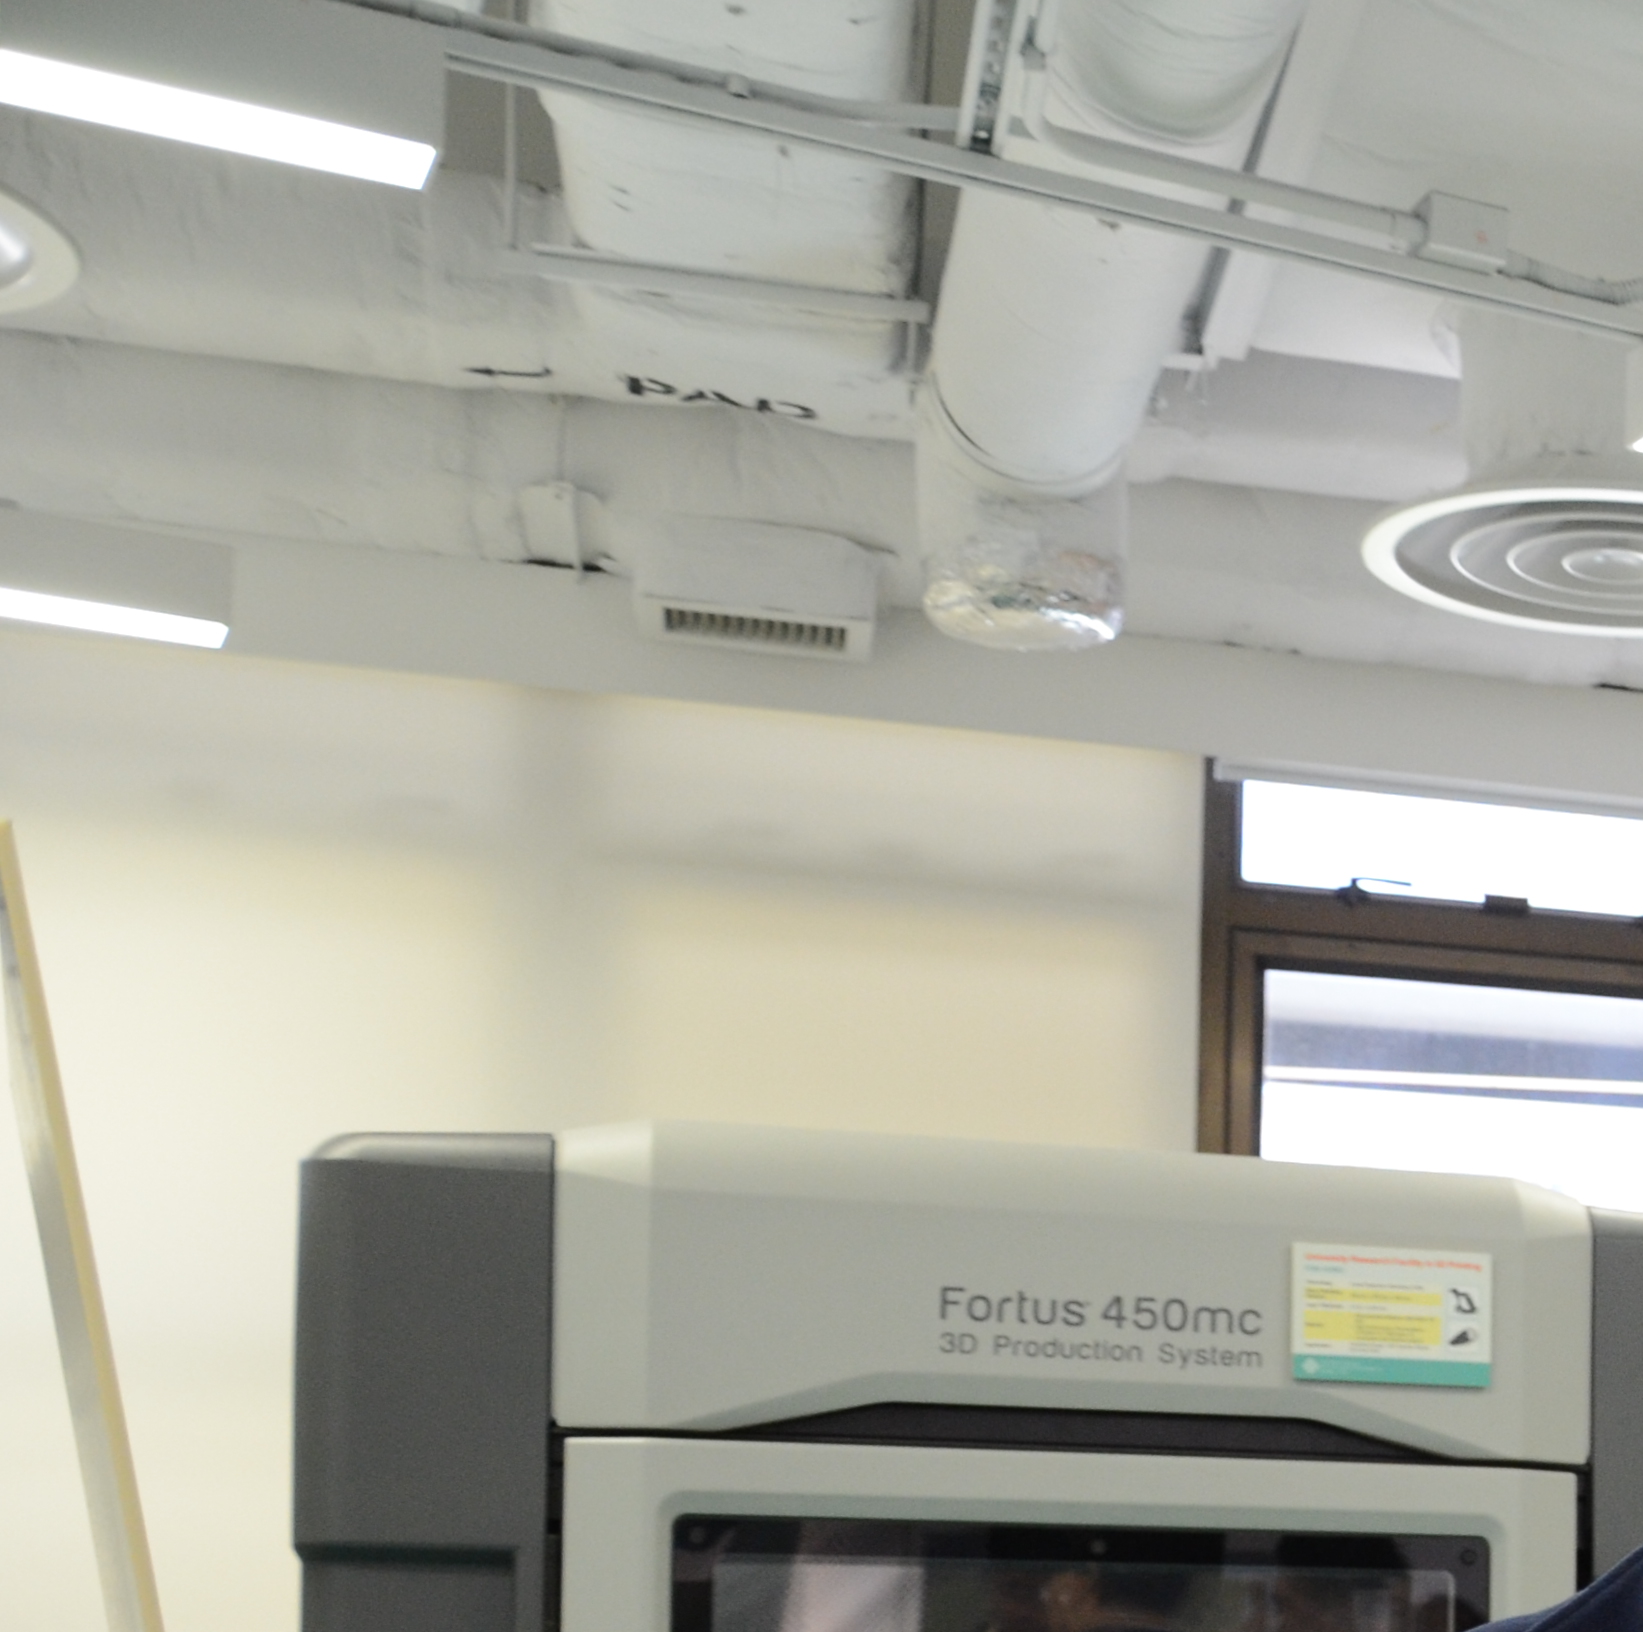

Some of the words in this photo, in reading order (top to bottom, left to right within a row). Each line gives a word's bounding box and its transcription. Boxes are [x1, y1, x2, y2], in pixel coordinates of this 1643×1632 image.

[939, 1286, 1086, 1328] Fortus
[1102, 1296, 1263, 1336] 450mc
[939, 1331, 978, 1355] 3D
[994, 1335, 1143, 1363] Production
[1158, 1342, 1263, 1371] System
